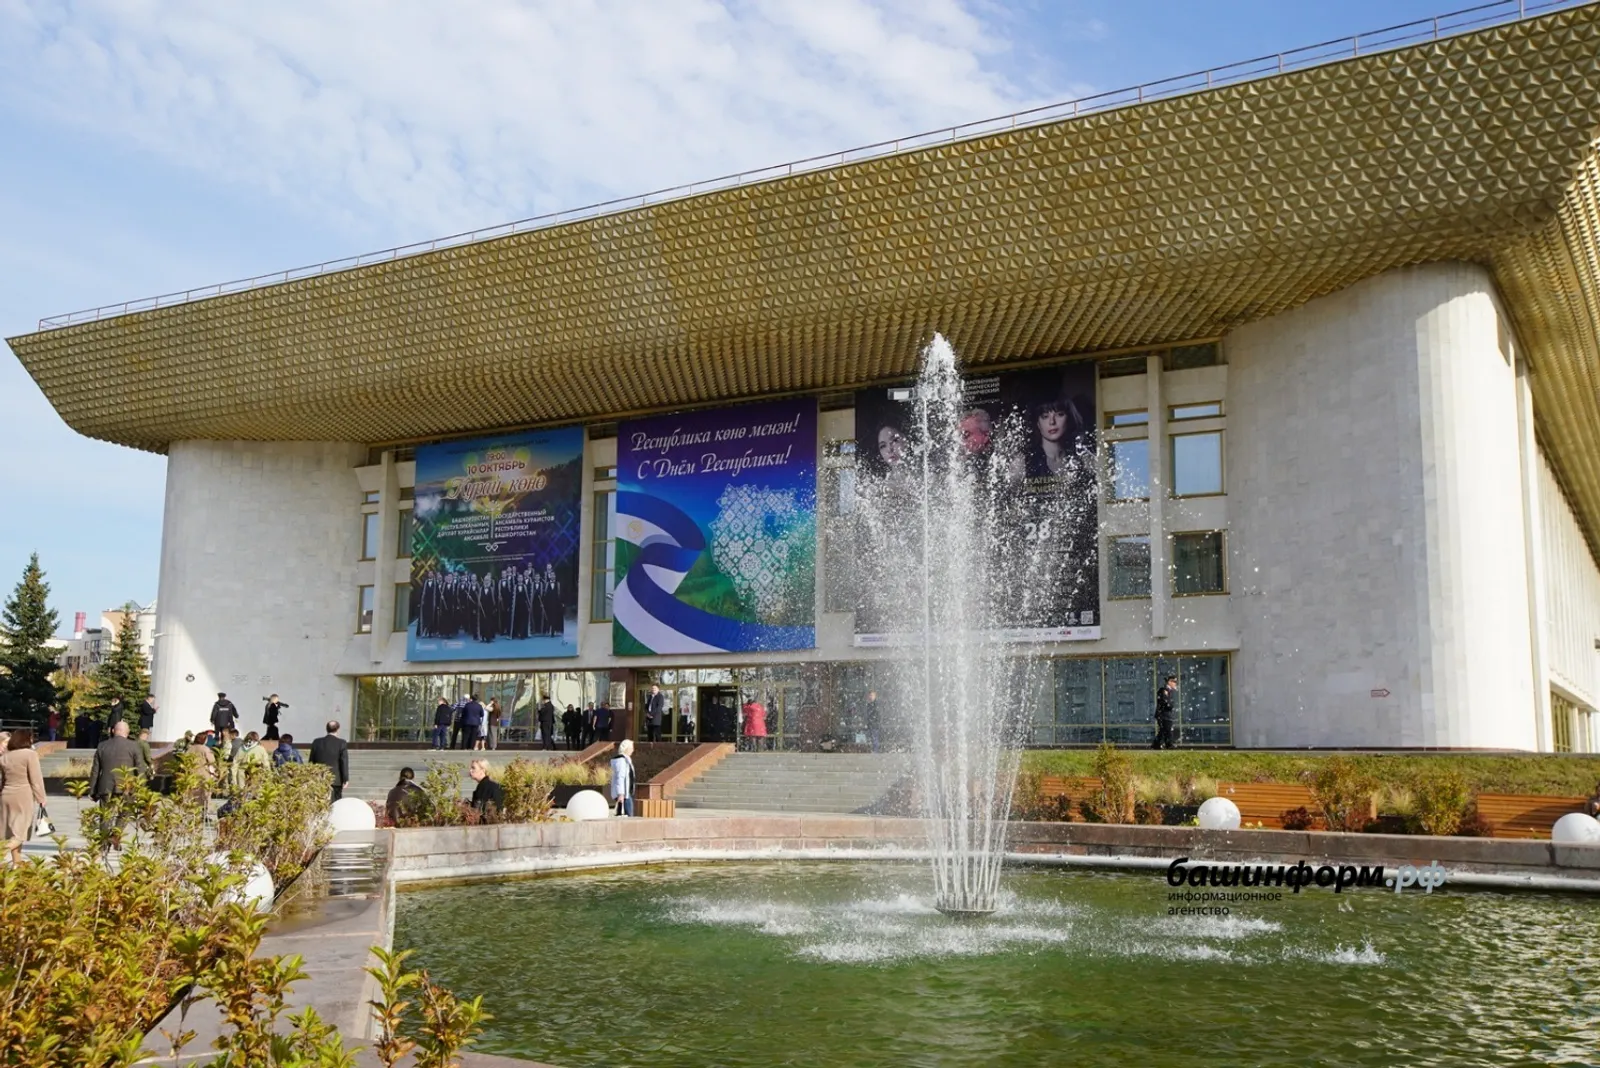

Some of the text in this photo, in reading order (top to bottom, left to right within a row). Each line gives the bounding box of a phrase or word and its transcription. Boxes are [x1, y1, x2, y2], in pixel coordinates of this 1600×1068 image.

[630, 413, 801, 455] Республика көнө менән!
[468, 461, 526, 475] 10 ОКТЯБРЬ
[637, 444, 793, 480] С Днём Республики!
[495, 509, 547, 520] ГОСУДАРСТВЕННЫЙ
[495, 517, 522, 526] АНСАМБЛЬ
[494, 524, 529, 532] РЕСПУБЛИКИ
[1025, 520, 1052, 540] 28
[494, 530, 537, 539] БАШКОРТОСТАН
